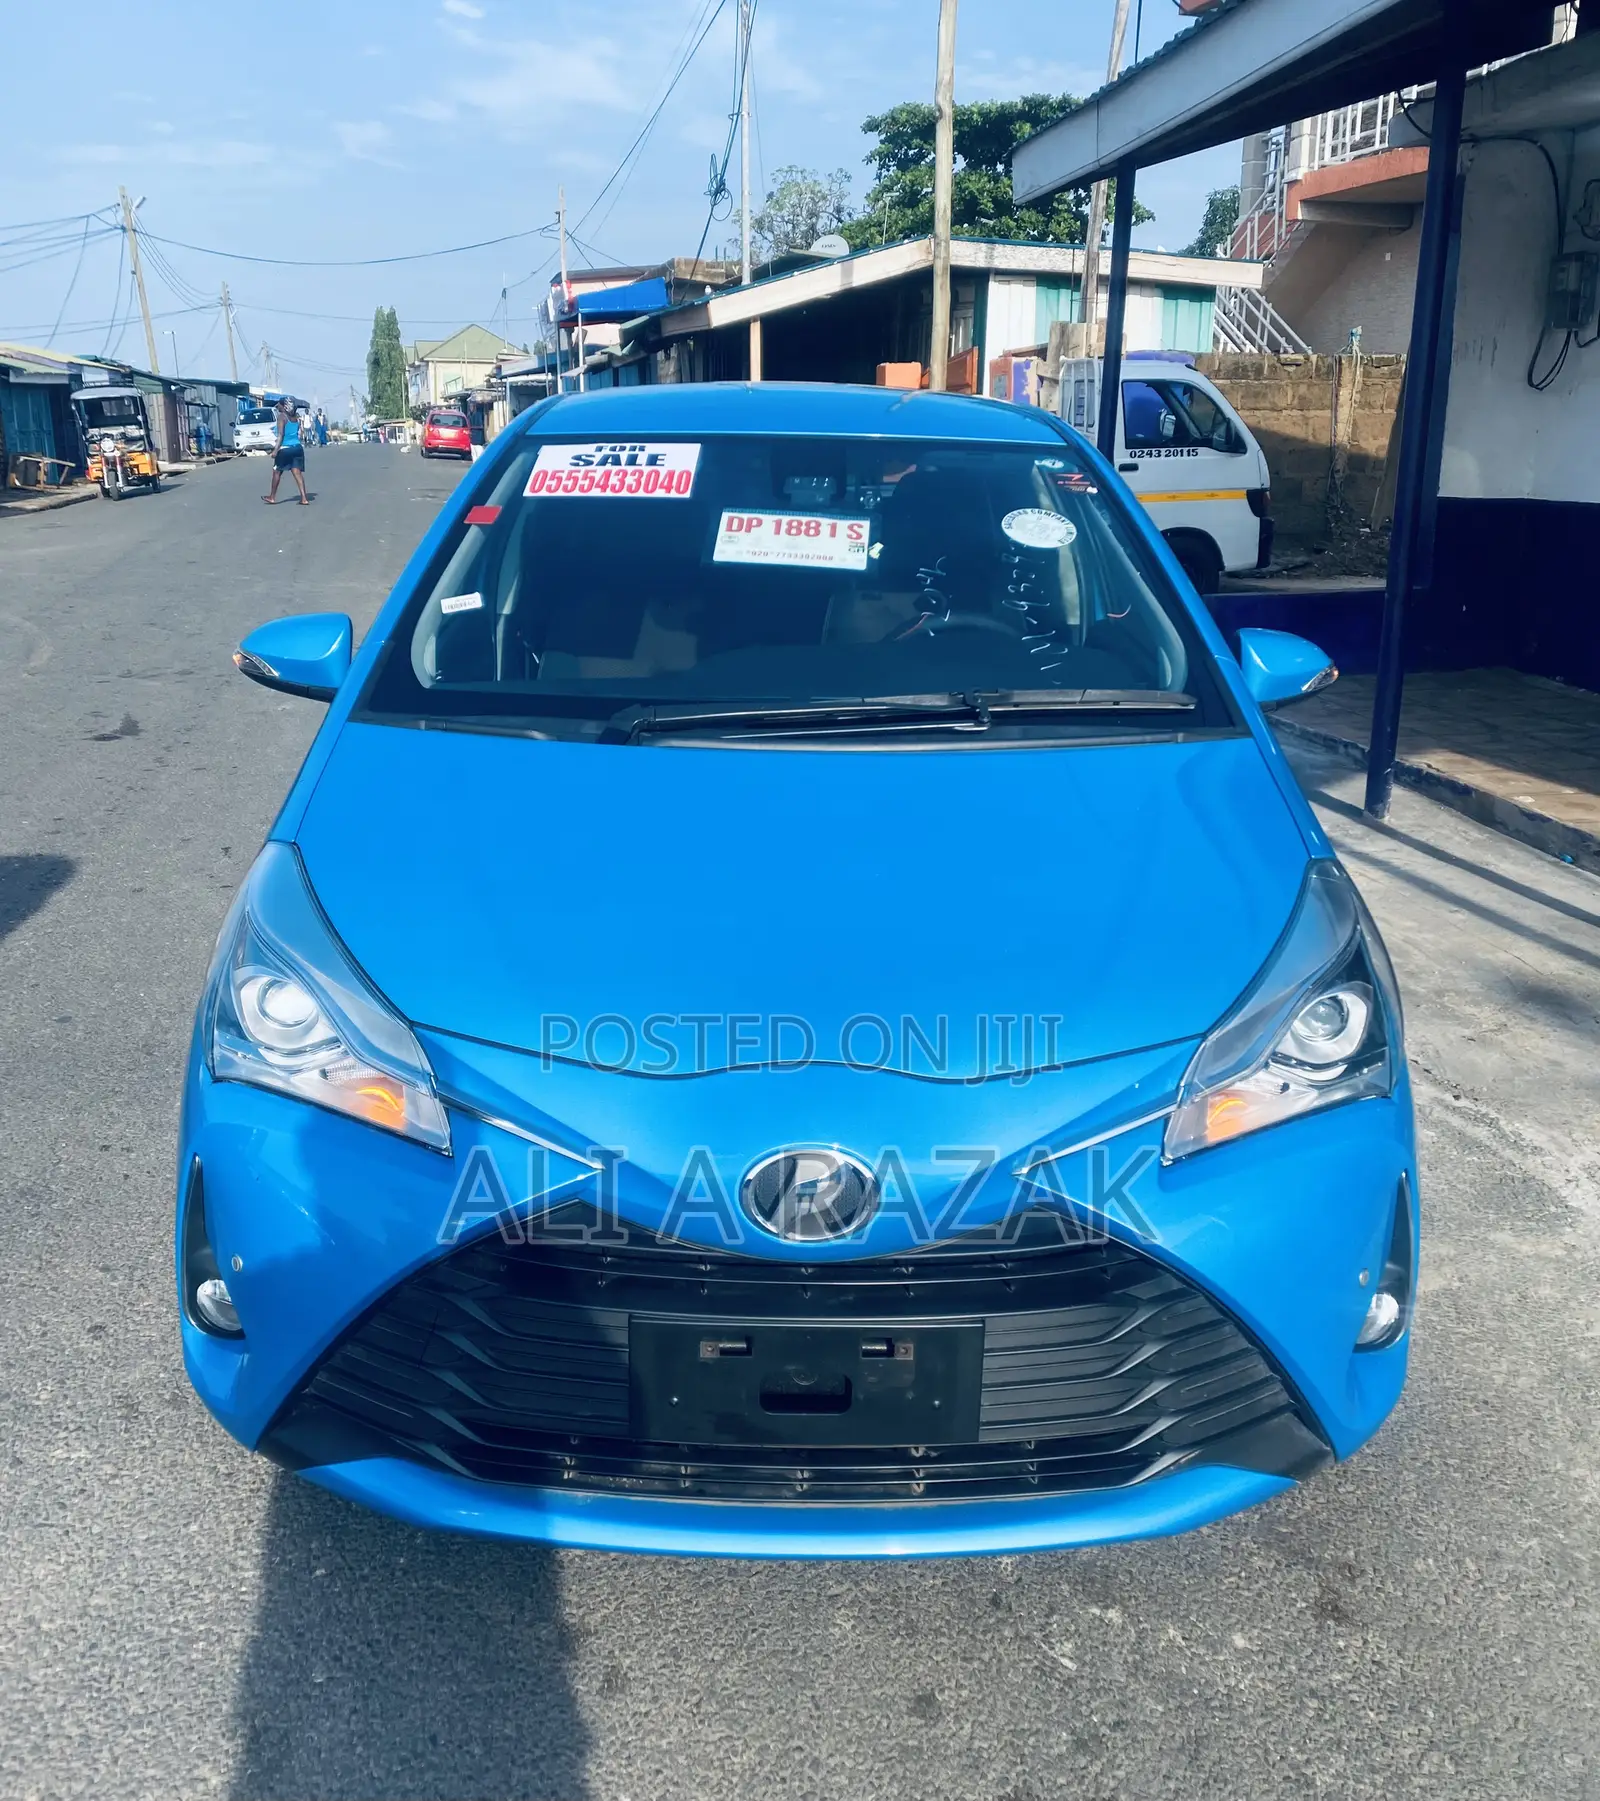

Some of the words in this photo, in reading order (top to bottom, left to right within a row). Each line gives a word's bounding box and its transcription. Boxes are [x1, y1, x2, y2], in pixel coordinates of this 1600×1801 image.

[569, 453, 666, 467] SALE
[1129, 449, 1162, 458] 0243
[529, 469, 692, 495] 0555433040
[725, 516, 763, 533] DP
[771, 518, 837, 538] 1881
[846, 523, 864, 541] S
